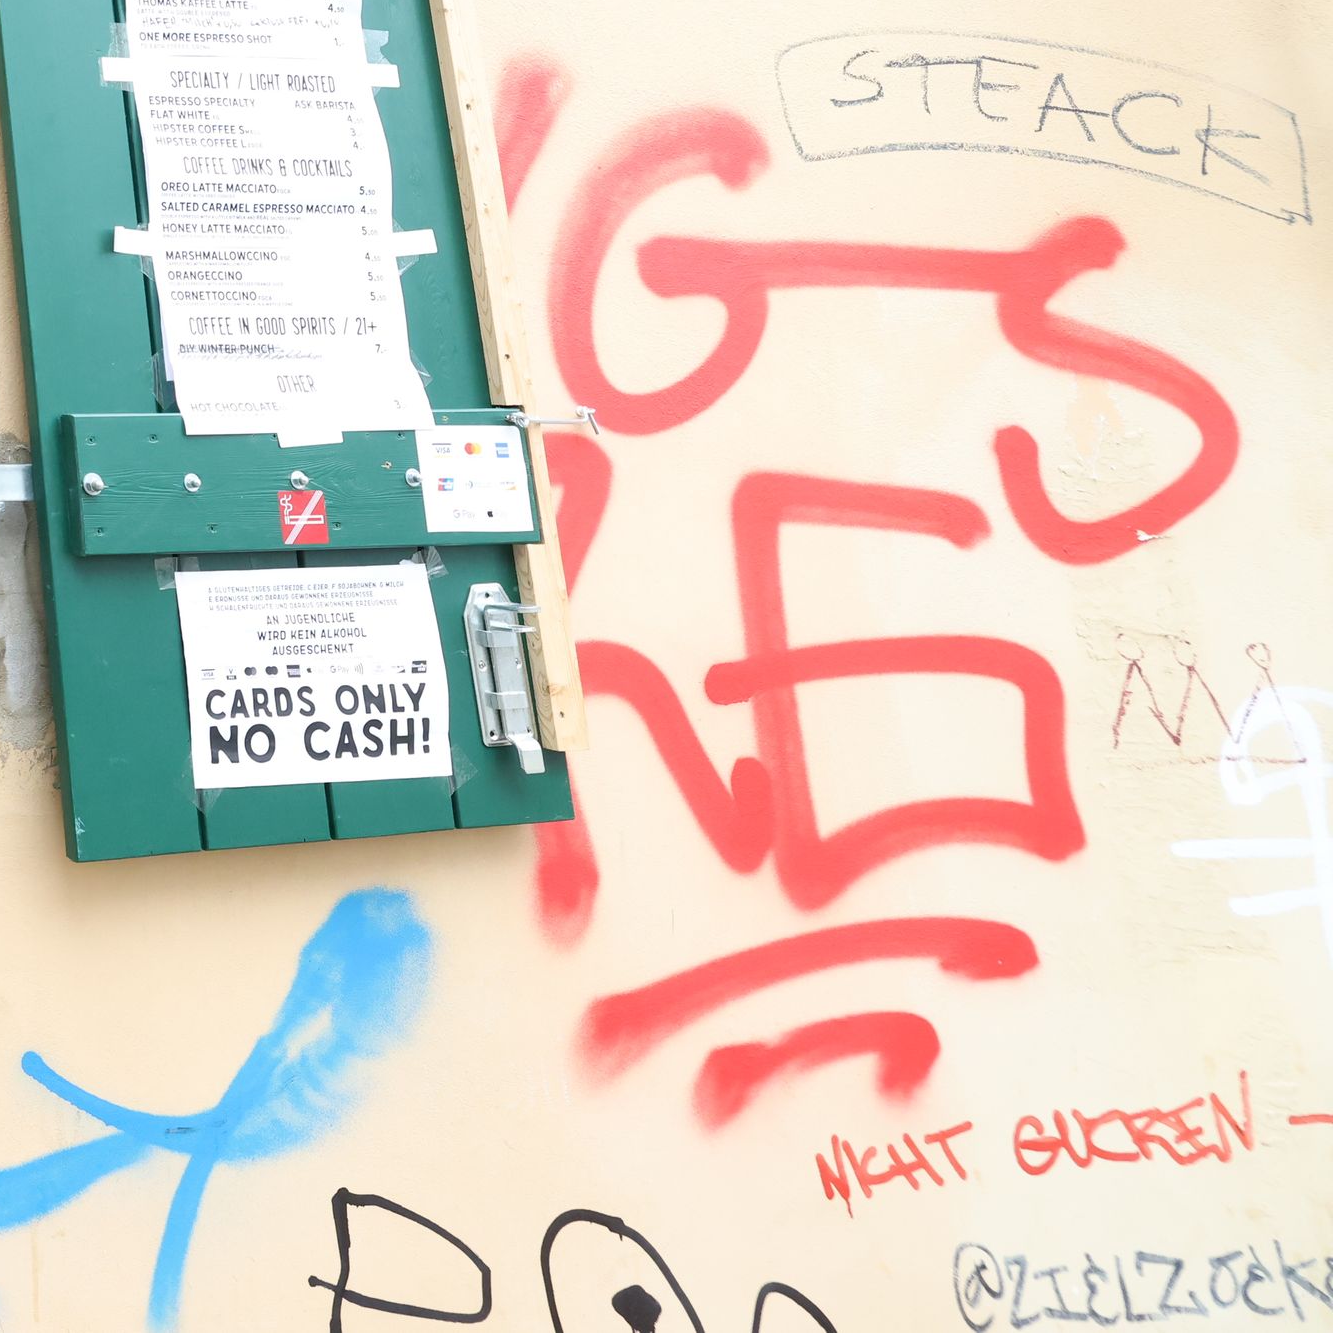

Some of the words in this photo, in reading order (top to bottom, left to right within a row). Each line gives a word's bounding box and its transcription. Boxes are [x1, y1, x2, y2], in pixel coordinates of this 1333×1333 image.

[162, 32, 191, 43] MORE
[193, 32, 245, 44] ESPRESSO
[170, 70, 230, 90] SPECIALTY
[249, 73, 281, 92] LIGHT
[286, 74, 337, 94] ROASTED
[148, 95, 201, 107] ESPRESSO
[177, 110, 211, 121] WHITE
[830, 48, 1273, 186] STEACK
[182, 155, 228, 176] COFFEE
[231, 157, 272, 177] DRINKS
[292, 159, 353, 179] COCKTAILS
[192, 182, 224, 194] LATTE
[160, 201, 200, 213] SALTED
[201, 202, 251, 214] CARAMEL
[252, 203, 304, 215] ESPRESSO
[162, 223, 198, 235] HONEY
[200, 224, 232, 235] LATTE
[165, 250, 279, 262] MARSHMALLOWCCINO
[167, 270, 244, 282] ORANGECCINO
[170, 290, 258, 302] CORNETTOCCINO
[188, 316, 234, 336] COFFEE
[255, 316, 287, 336] GOOD
[291, 316, 337, 336] SPIRITS
[276, 374, 318, 394] OTHER
[265, 615, 280, 626] AN
[284, 612, 356, 626] JUGENDLICHE
[257, 630, 287, 642] WIRD
[290, 629, 317, 641] KEIN
[320, 627, 368, 640] ALKOHOL
[271, 643, 355, 656] AUSGESCHENKT
[205, 685, 317, 720] CARDS
[334, 681, 427, 716] ONLY
[209, 722, 276, 765] NO
[303, 717, 431, 762] CASH!
[815, 1121, 974, 1218] NICHT
